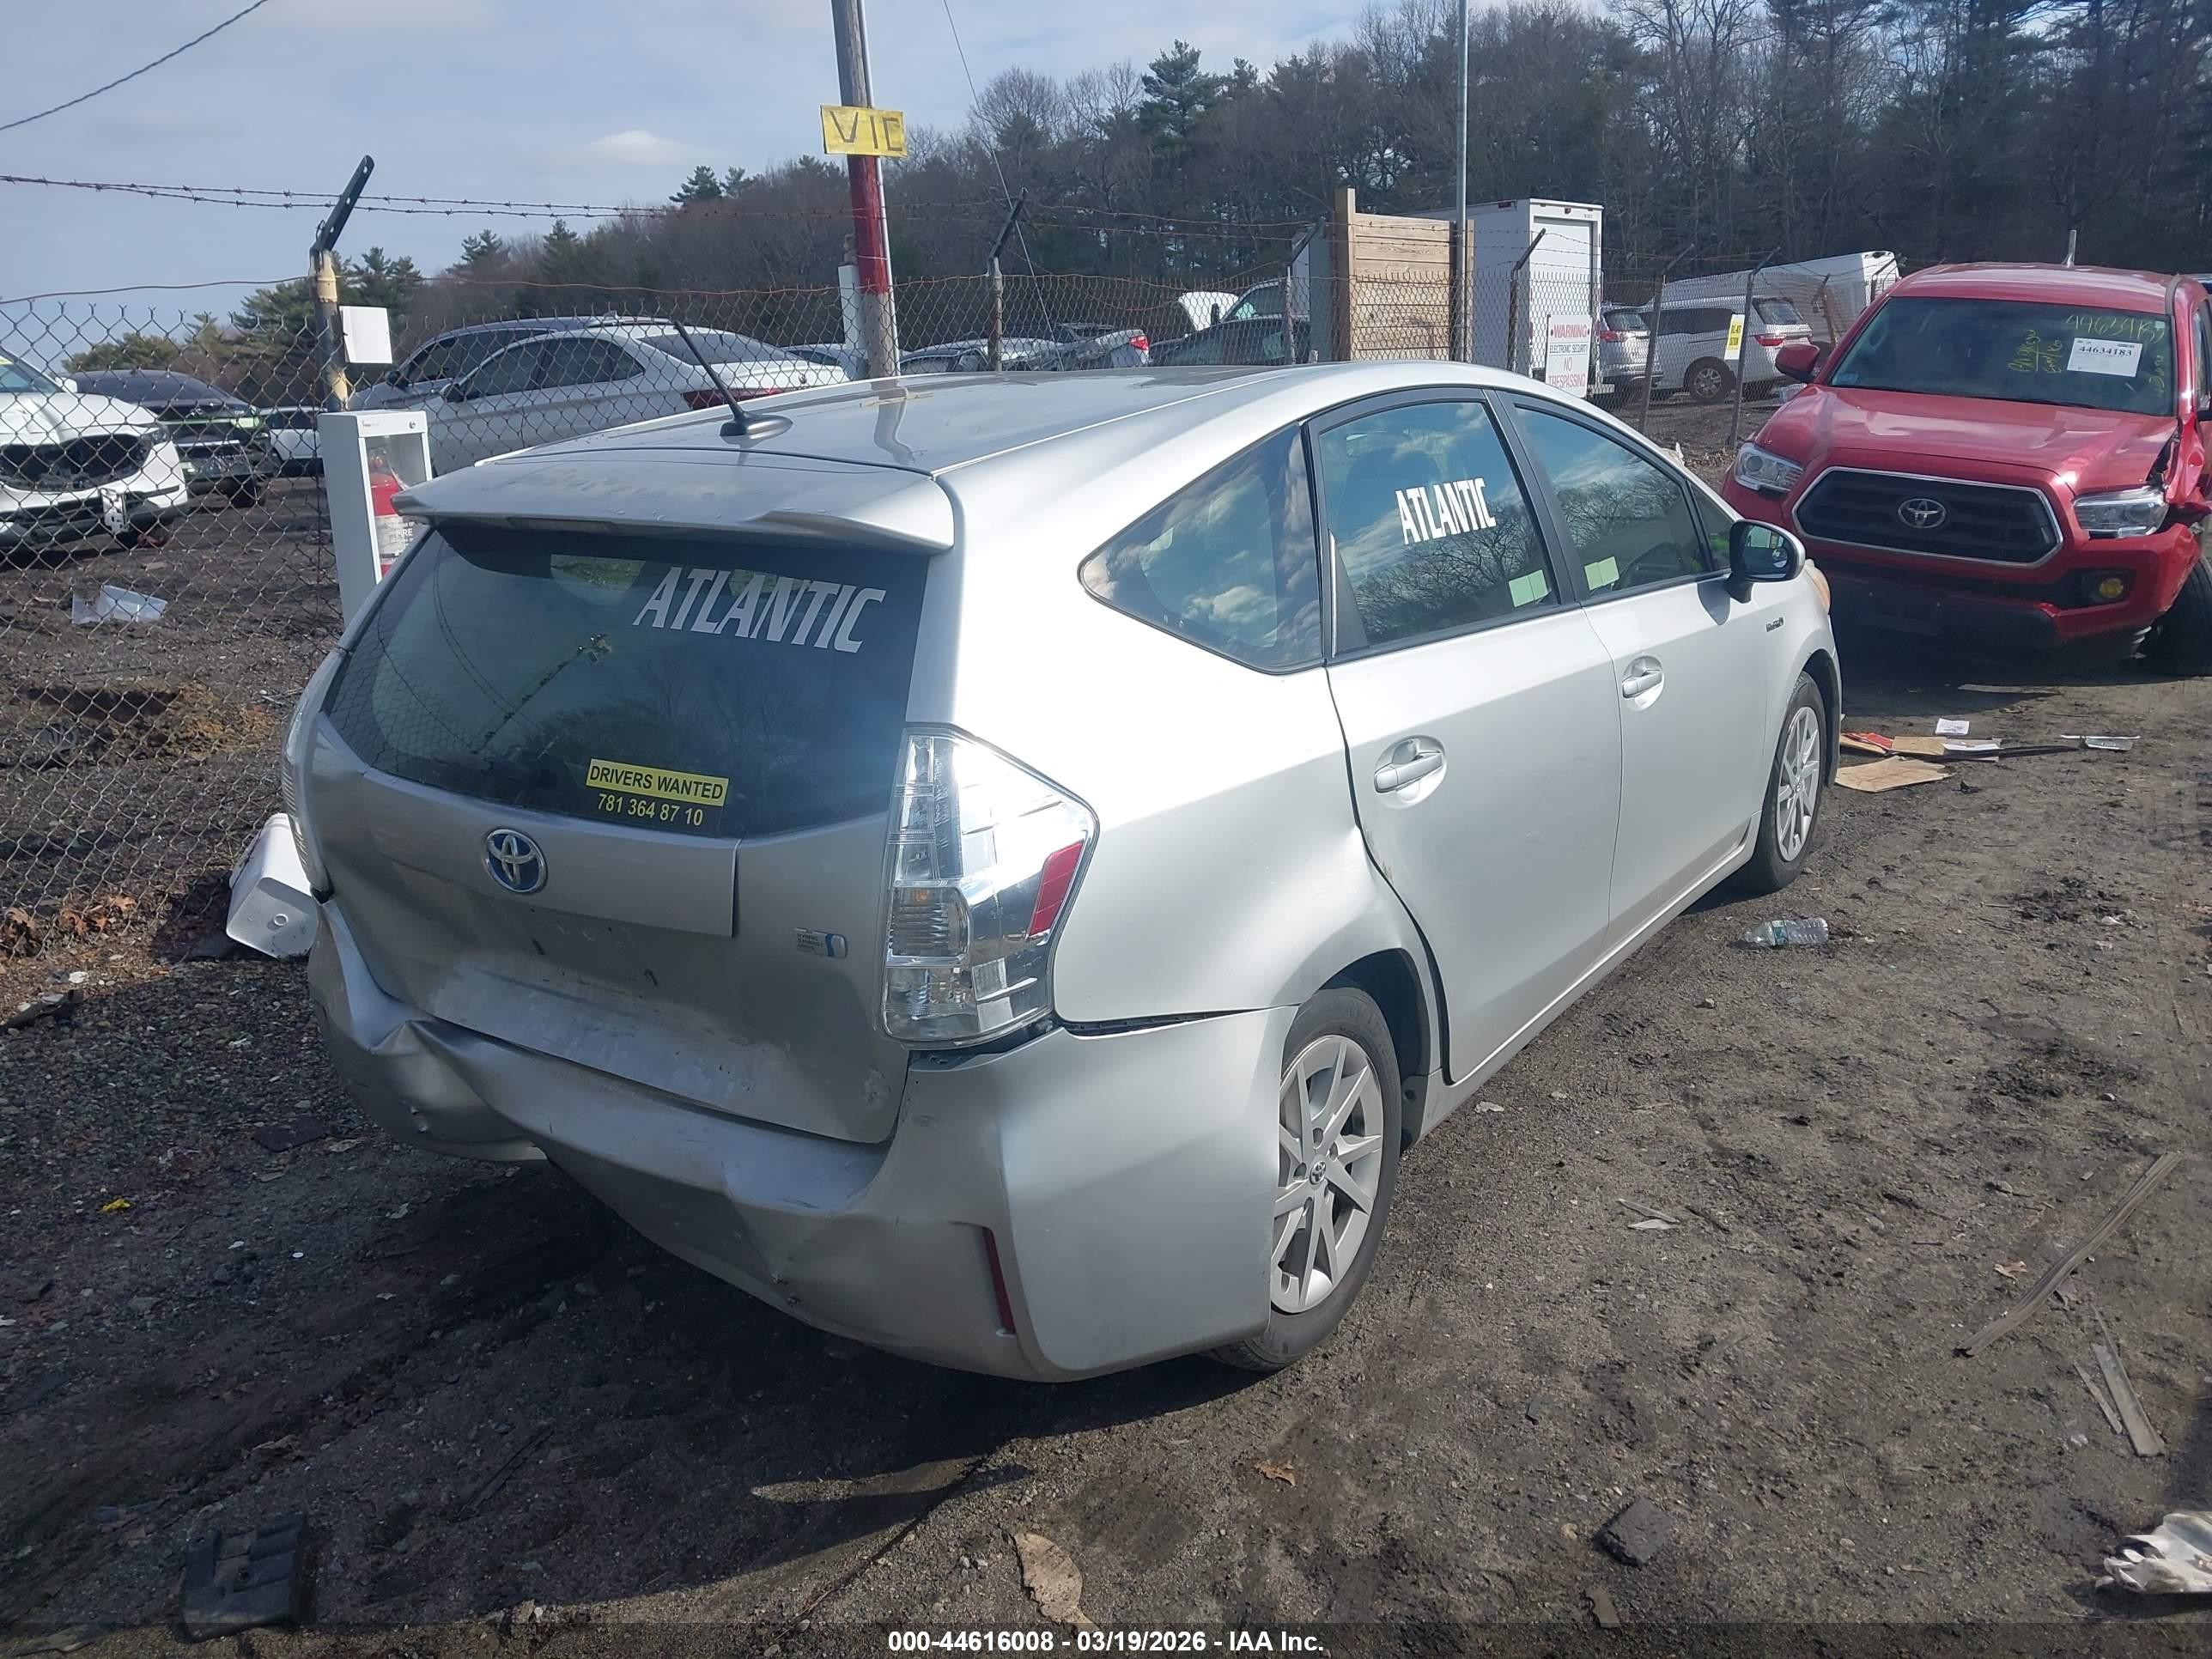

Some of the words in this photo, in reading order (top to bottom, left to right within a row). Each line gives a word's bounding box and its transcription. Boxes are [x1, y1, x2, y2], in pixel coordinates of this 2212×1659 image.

[830, 110, 902, 152] VIC
[1553, 325, 1587, 338] WARNING
[1549, 344, 1571, 353] ELECTRONIC
[2078, 345, 2133, 356] 44634183
[1564, 357, 1572, 372] NO
[1548, 374, 1586, 388] TRESPASSING
[1395, 477, 1497, 545] ATLANTIC
[632, 566, 886, 653] ATLANTIC
[589, 765, 653, 789] DRIVERS
[657, 775, 724, 799] WANTED
[598, 793, 624, 814] 781
[628, 798, 656, 818] 364
[659, 803, 681, 823] 87
[684, 807, 704, 827] 10
